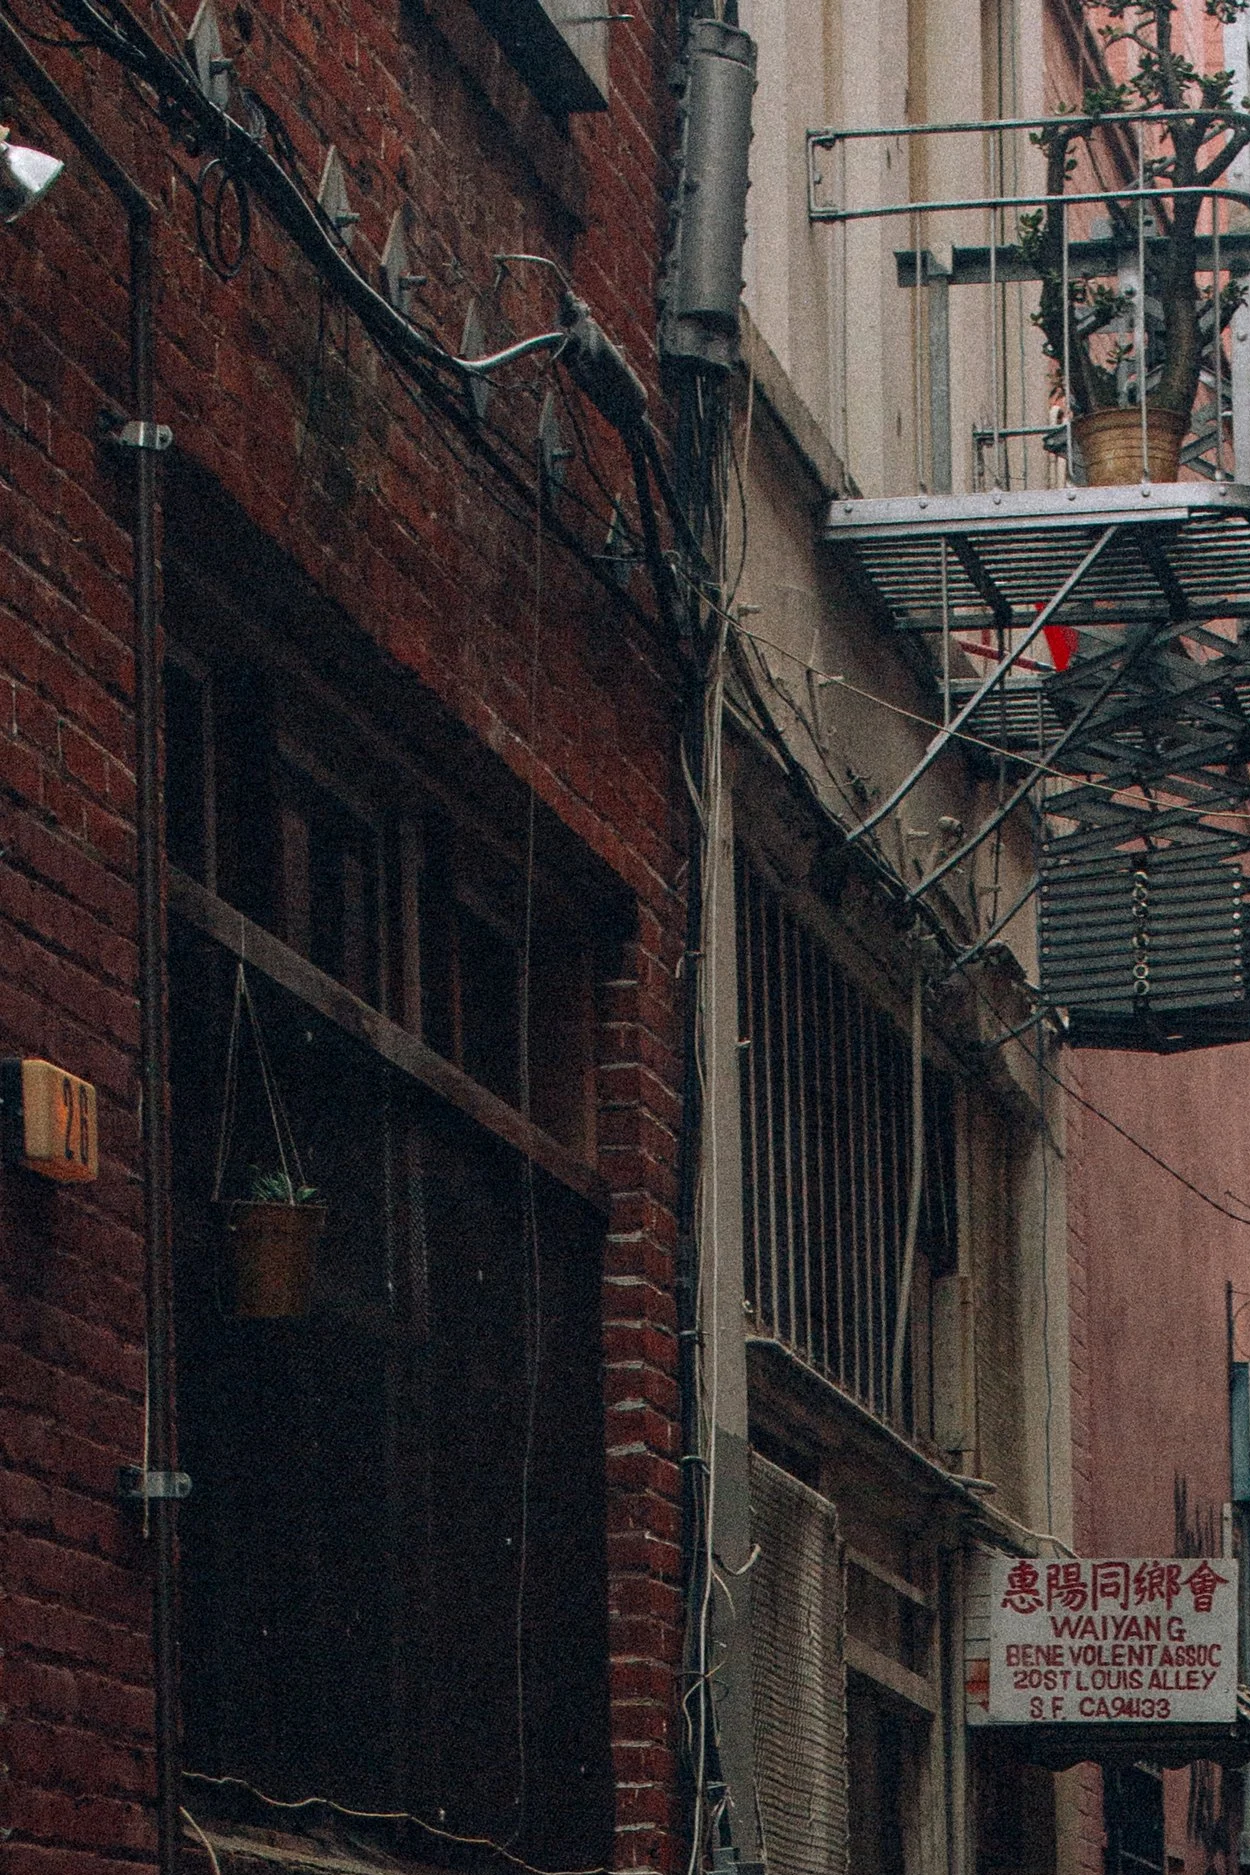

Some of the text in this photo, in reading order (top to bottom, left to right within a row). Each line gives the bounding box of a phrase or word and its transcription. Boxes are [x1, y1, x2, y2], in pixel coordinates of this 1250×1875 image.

[1001, 1560, 1230, 1614] 惠陽同鄉會
[1076, 1669, 1143, 1691] LOUIS
[1148, 1669, 1217, 1691] ALLEY
